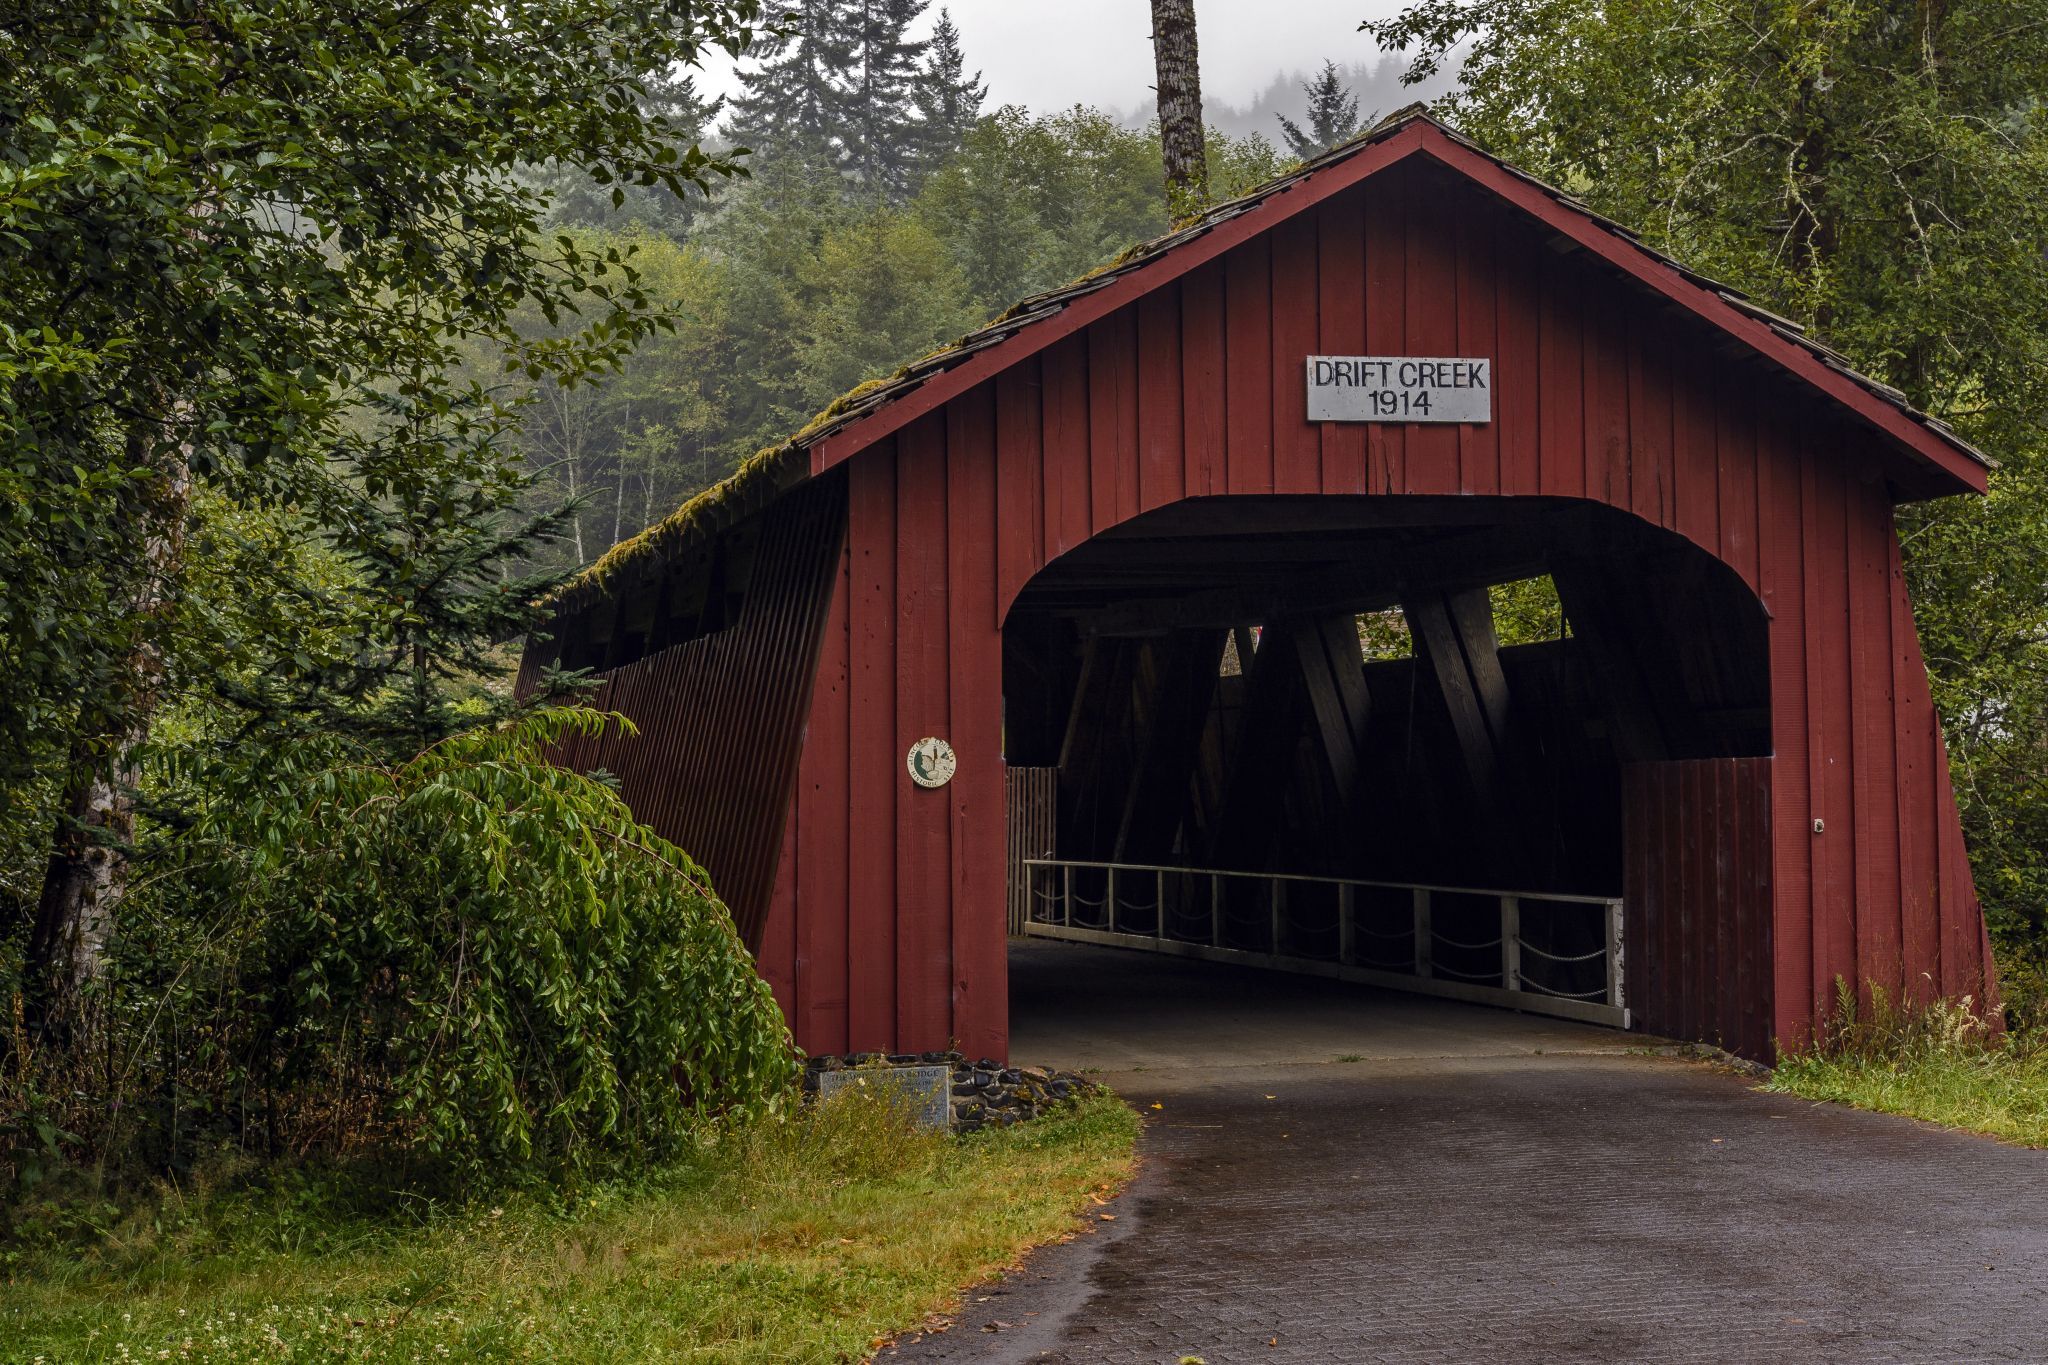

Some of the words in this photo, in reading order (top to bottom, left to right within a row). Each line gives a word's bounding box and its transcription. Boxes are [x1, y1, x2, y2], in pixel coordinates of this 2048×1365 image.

[1315, 361, 1392, 387] DRIFT
[1399, 362, 1486, 388] CREEK
[1368, 390, 1432, 416] 1914
